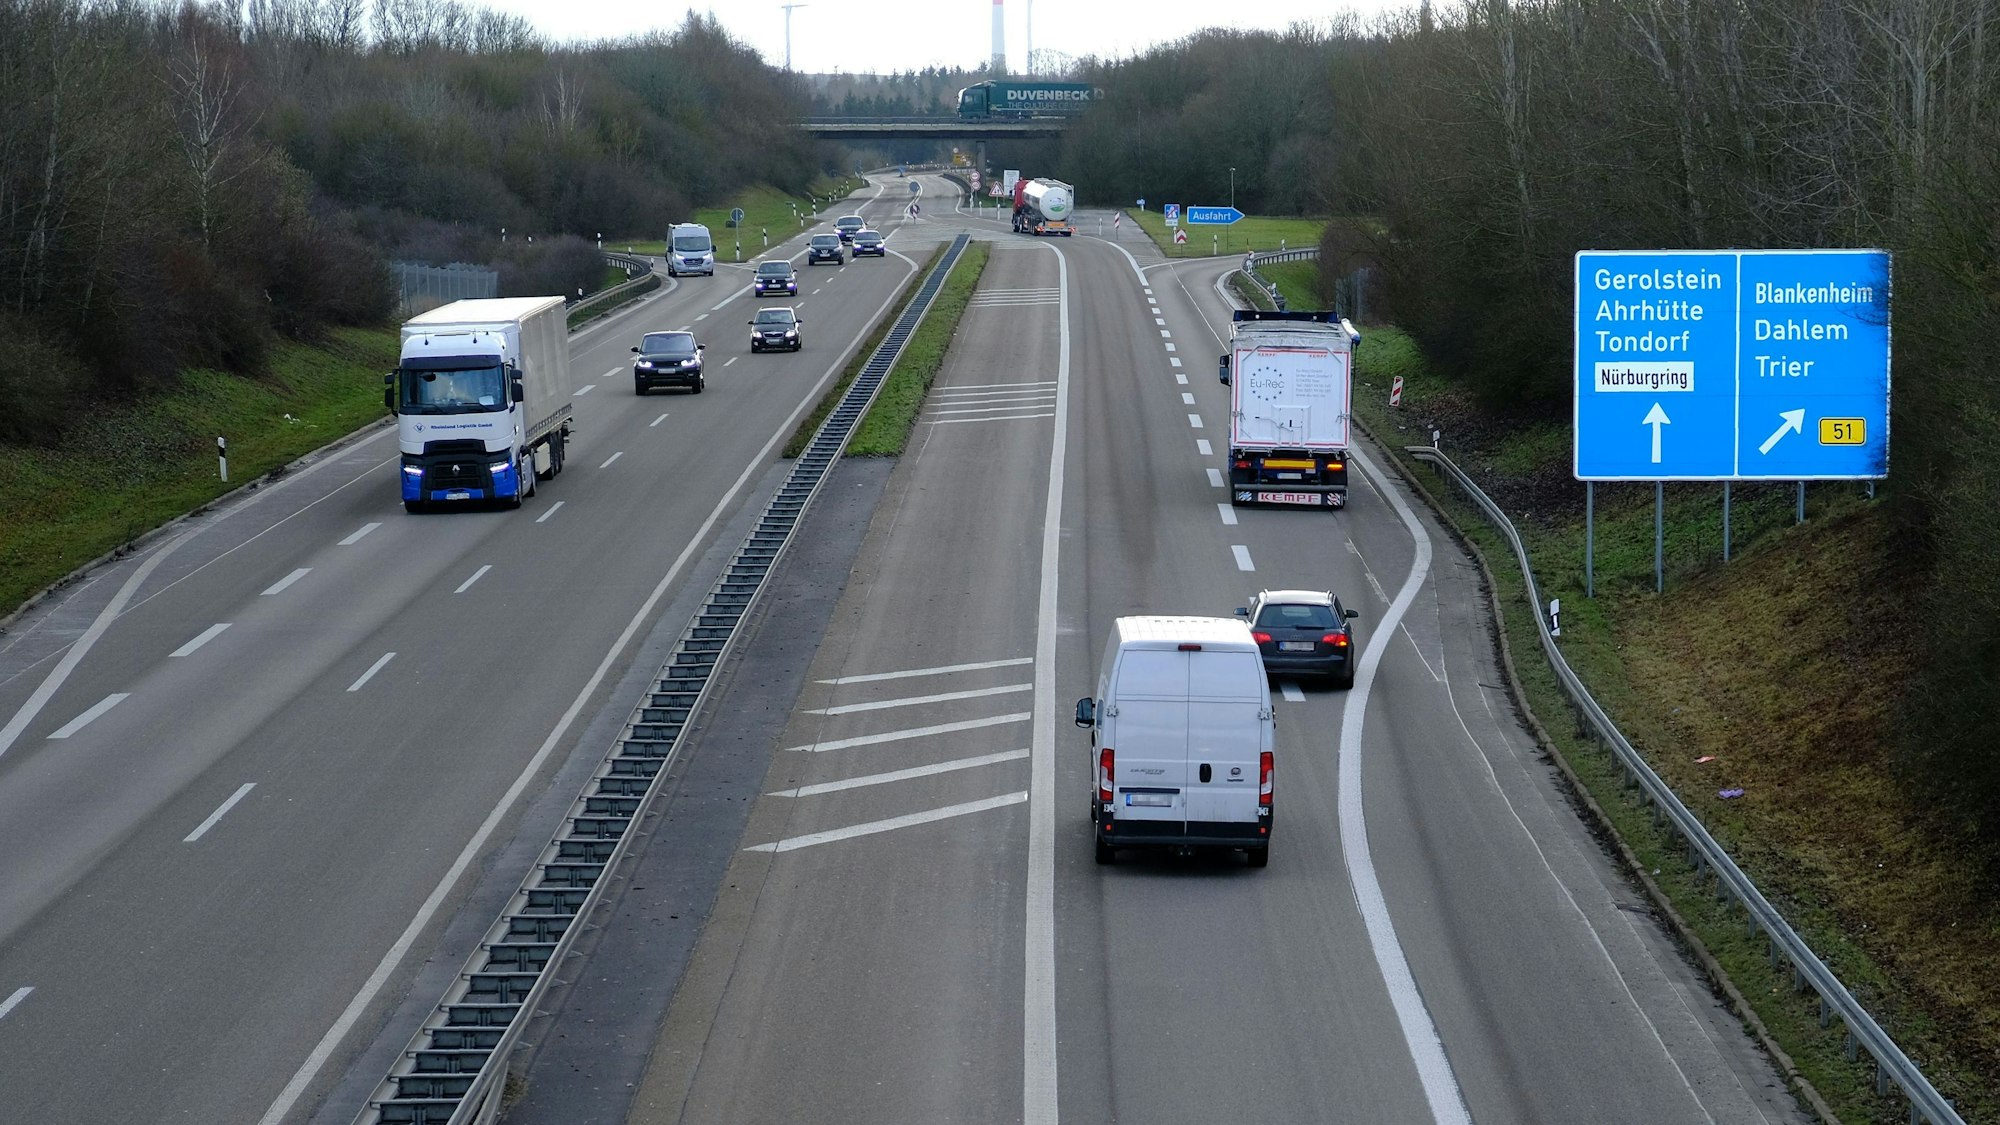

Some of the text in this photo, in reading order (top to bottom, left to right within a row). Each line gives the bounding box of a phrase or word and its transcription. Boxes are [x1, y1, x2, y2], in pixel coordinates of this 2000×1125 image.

[1007, 90, 1089, 100] DUVENBECK
[1192, 211, 1231, 220] Ausfahrt
[1595, 268, 1722, 290] Gerolstein
[1755, 282, 1873, 304] Blankenheim
[1595, 300, 1704, 321] Ahrhütte
[1755, 319, 1848, 341] Dahlem
[1595, 330, 1690, 352] Tondorf
[1755, 356, 1815, 377] Trier
[1250, 379, 1285, 388] Eu-Rec
[1601, 368, 1688, 389] Nürburgring
[1833, 423, 1852, 440] 51
[1260, 493, 1320, 502] KEMPF
